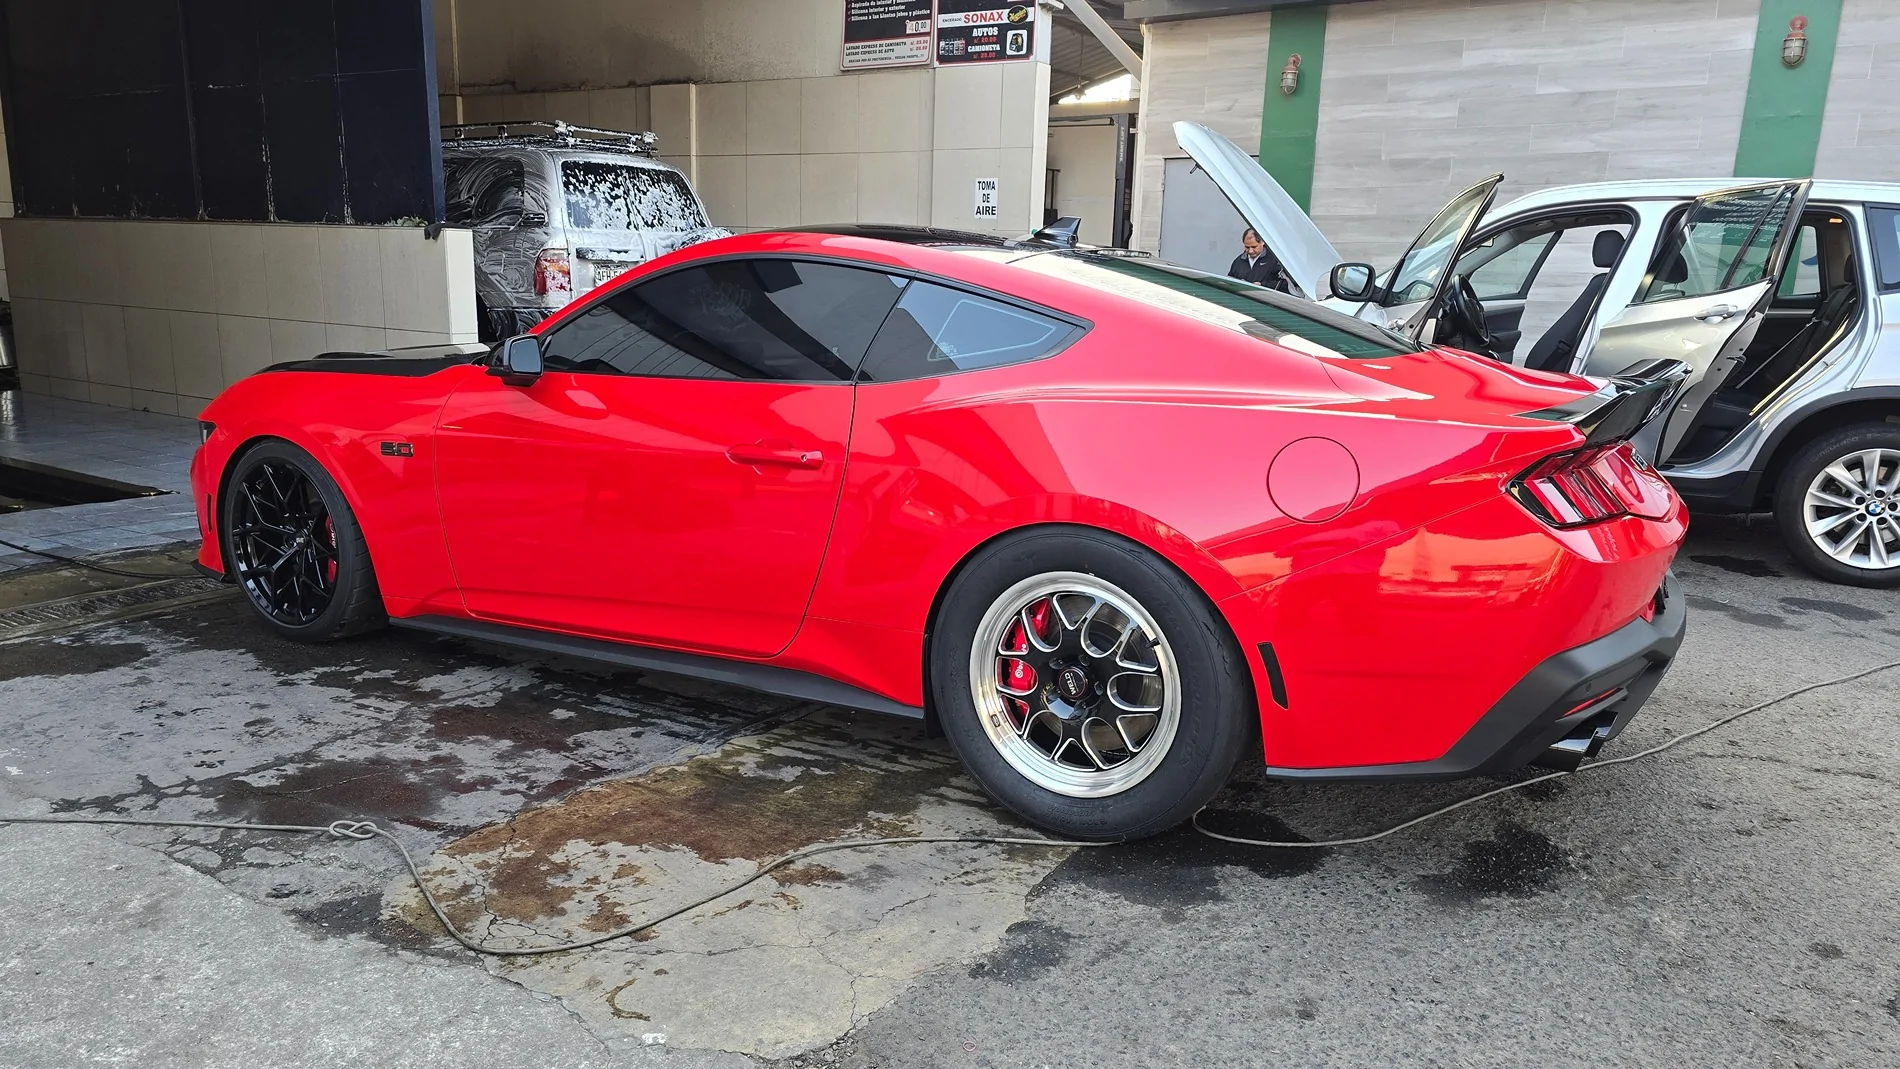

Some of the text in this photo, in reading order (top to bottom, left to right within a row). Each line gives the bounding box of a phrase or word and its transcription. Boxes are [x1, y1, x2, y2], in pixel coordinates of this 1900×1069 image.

[963, 11, 1004, 24] SONAX
[972, 27, 998, 37] AUTOS
[967, 44, 1001, 52] CAMIONETA
[977, 181, 996, 190] TOMA
[982, 193, 991, 203] DE
[975, 205, 997, 216] AIRE
[1064, 672, 1076, 695] WELD
